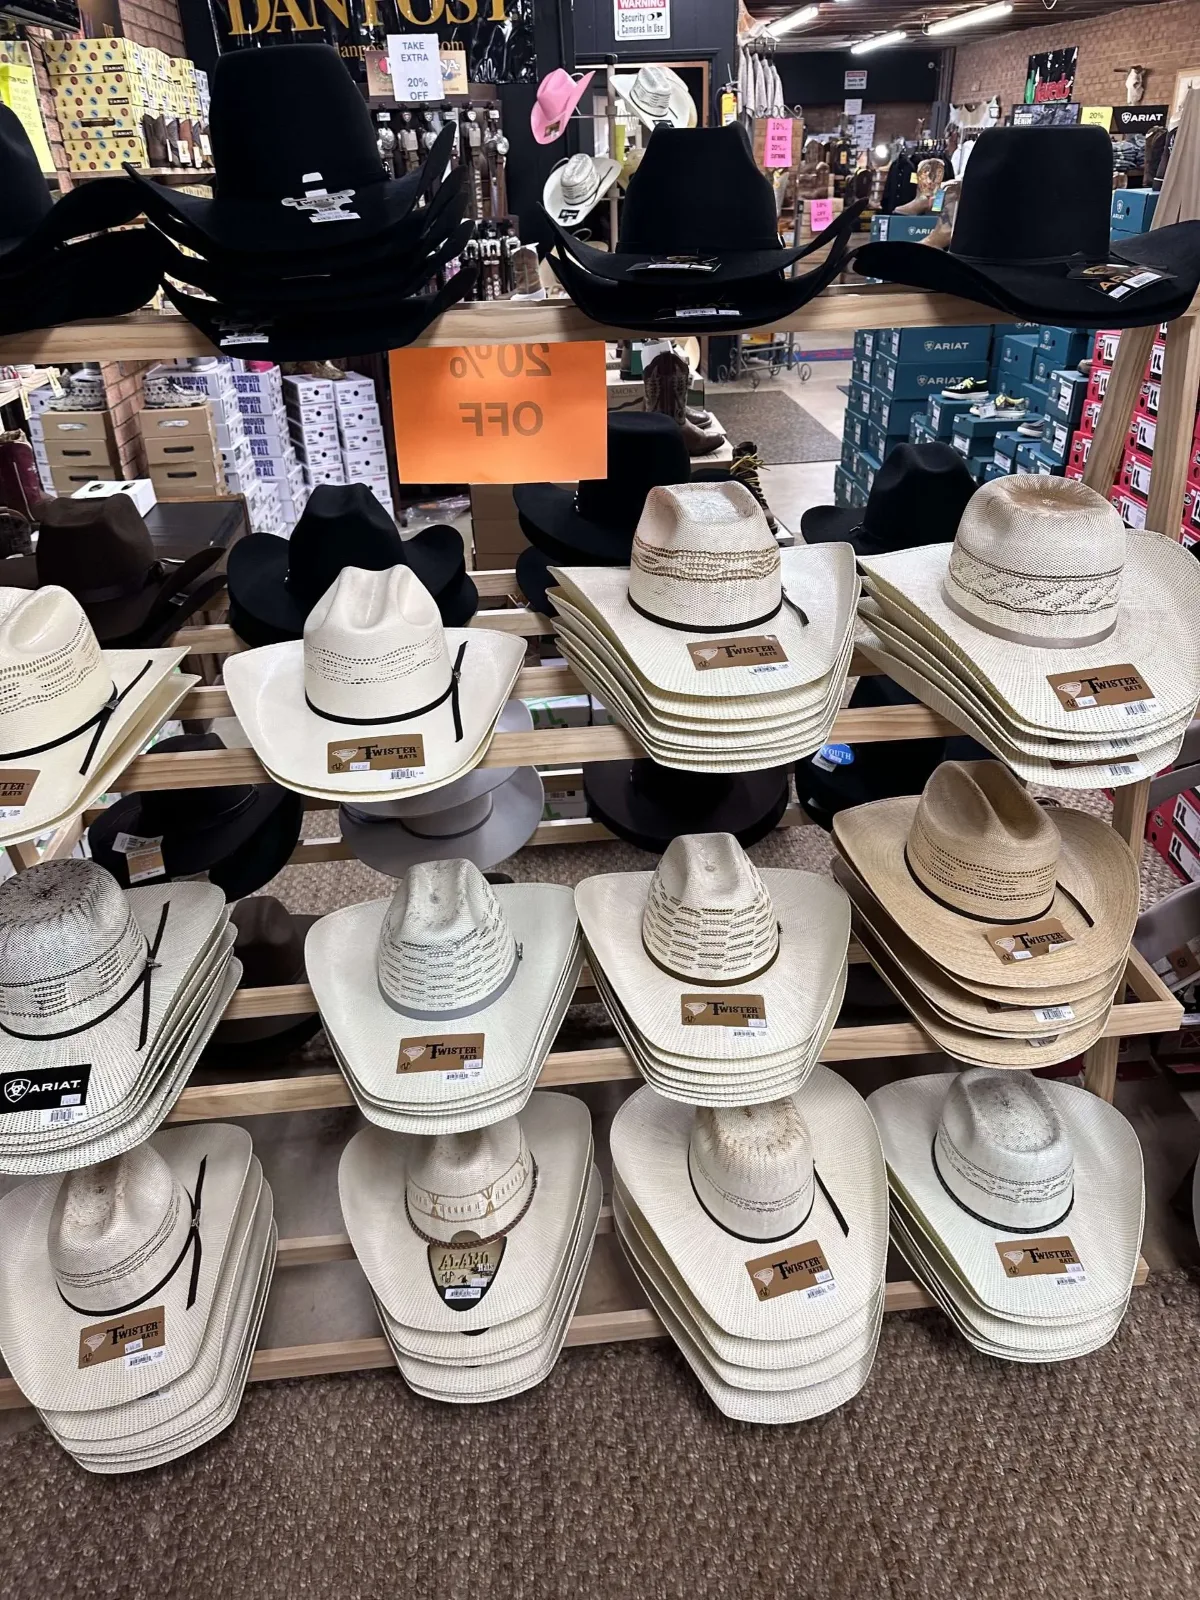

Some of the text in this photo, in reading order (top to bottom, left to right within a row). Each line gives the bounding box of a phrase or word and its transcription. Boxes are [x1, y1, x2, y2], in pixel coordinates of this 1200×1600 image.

[620, 0, 665, 8] WARNING
[228, 0, 349, 35] DAN
[621, 13, 645, 23] Security
[621, 24, 664, 34] Cameras In Use
[402, 42, 424, 50] TAKE
[401, 53, 429, 62] EXTRA
[407, 78, 428, 87] 20%
[410, 92, 428, 100] OFF
[1131, 113, 1163, 122] ARIAT
[934, 342, 969, 350] ARIAT
[237, 375, 260, 383] PROVEN
[249, 383, 261, 393] ALL
[239, 404, 262, 414] OR ALL
[244, 426, 266, 435] OR ALL
[249, 439, 268, 447] ROVEN
[257, 447, 269, 456] ALL
[263, 467, 275, 476] ALL
[717, 644, 775, 658] TWISTER
[1079, 677, 1139, 694] TWISTER
[358, 744, 416, 759] TWISTER
[823, 747, 851, 761] YOUTH
[1012, 932, 1064, 949] TWISTER
[706, 1001, 758, 1016] TWISTER
[426, 1043, 477, 1059] TWISTER
[29, 1080, 81, 1093] ARIAT
[1022, 1247, 1073, 1263] TWISTER
[438, 1252, 489, 1270] ALAMO
[772, 1256, 821, 1280] TWISTER
[808, 1266, 824, 1274] HATS
[107, 1321, 158, 1345] TWISTER
[141, 1331, 159, 1339] HATS
